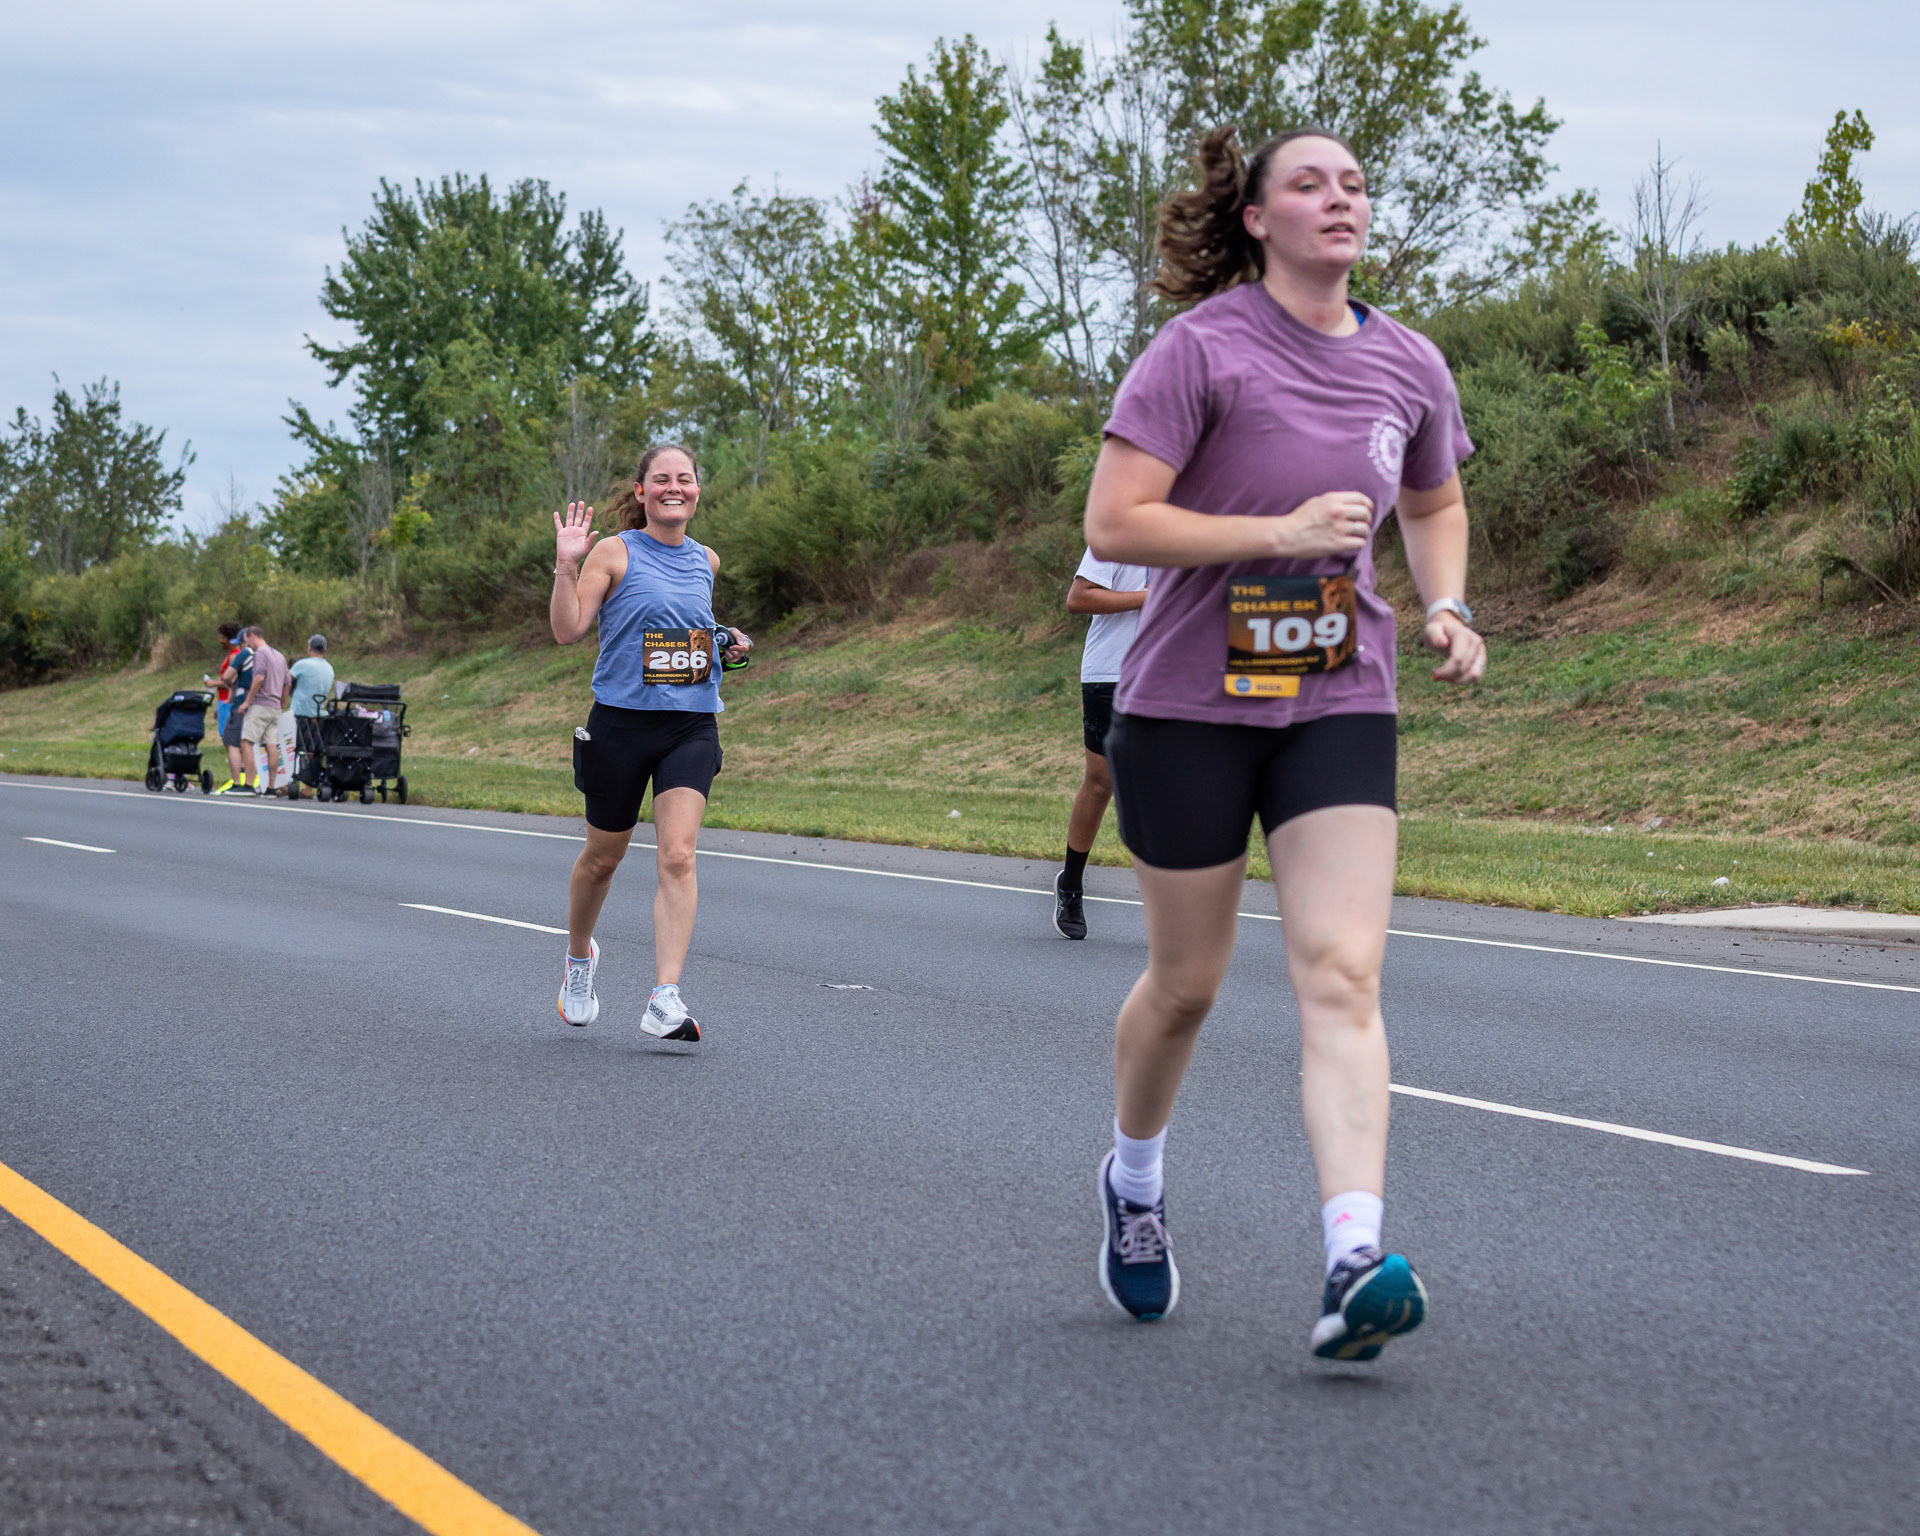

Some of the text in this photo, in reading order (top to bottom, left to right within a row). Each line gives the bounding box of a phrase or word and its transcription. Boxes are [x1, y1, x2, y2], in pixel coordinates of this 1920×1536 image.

[1231, 585, 1265, 597] THE
[1231, 600, 1318, 613] CHASE 5K
[1247, 612, 1348, 653] 109
[649, 651, 708, 669] 266
